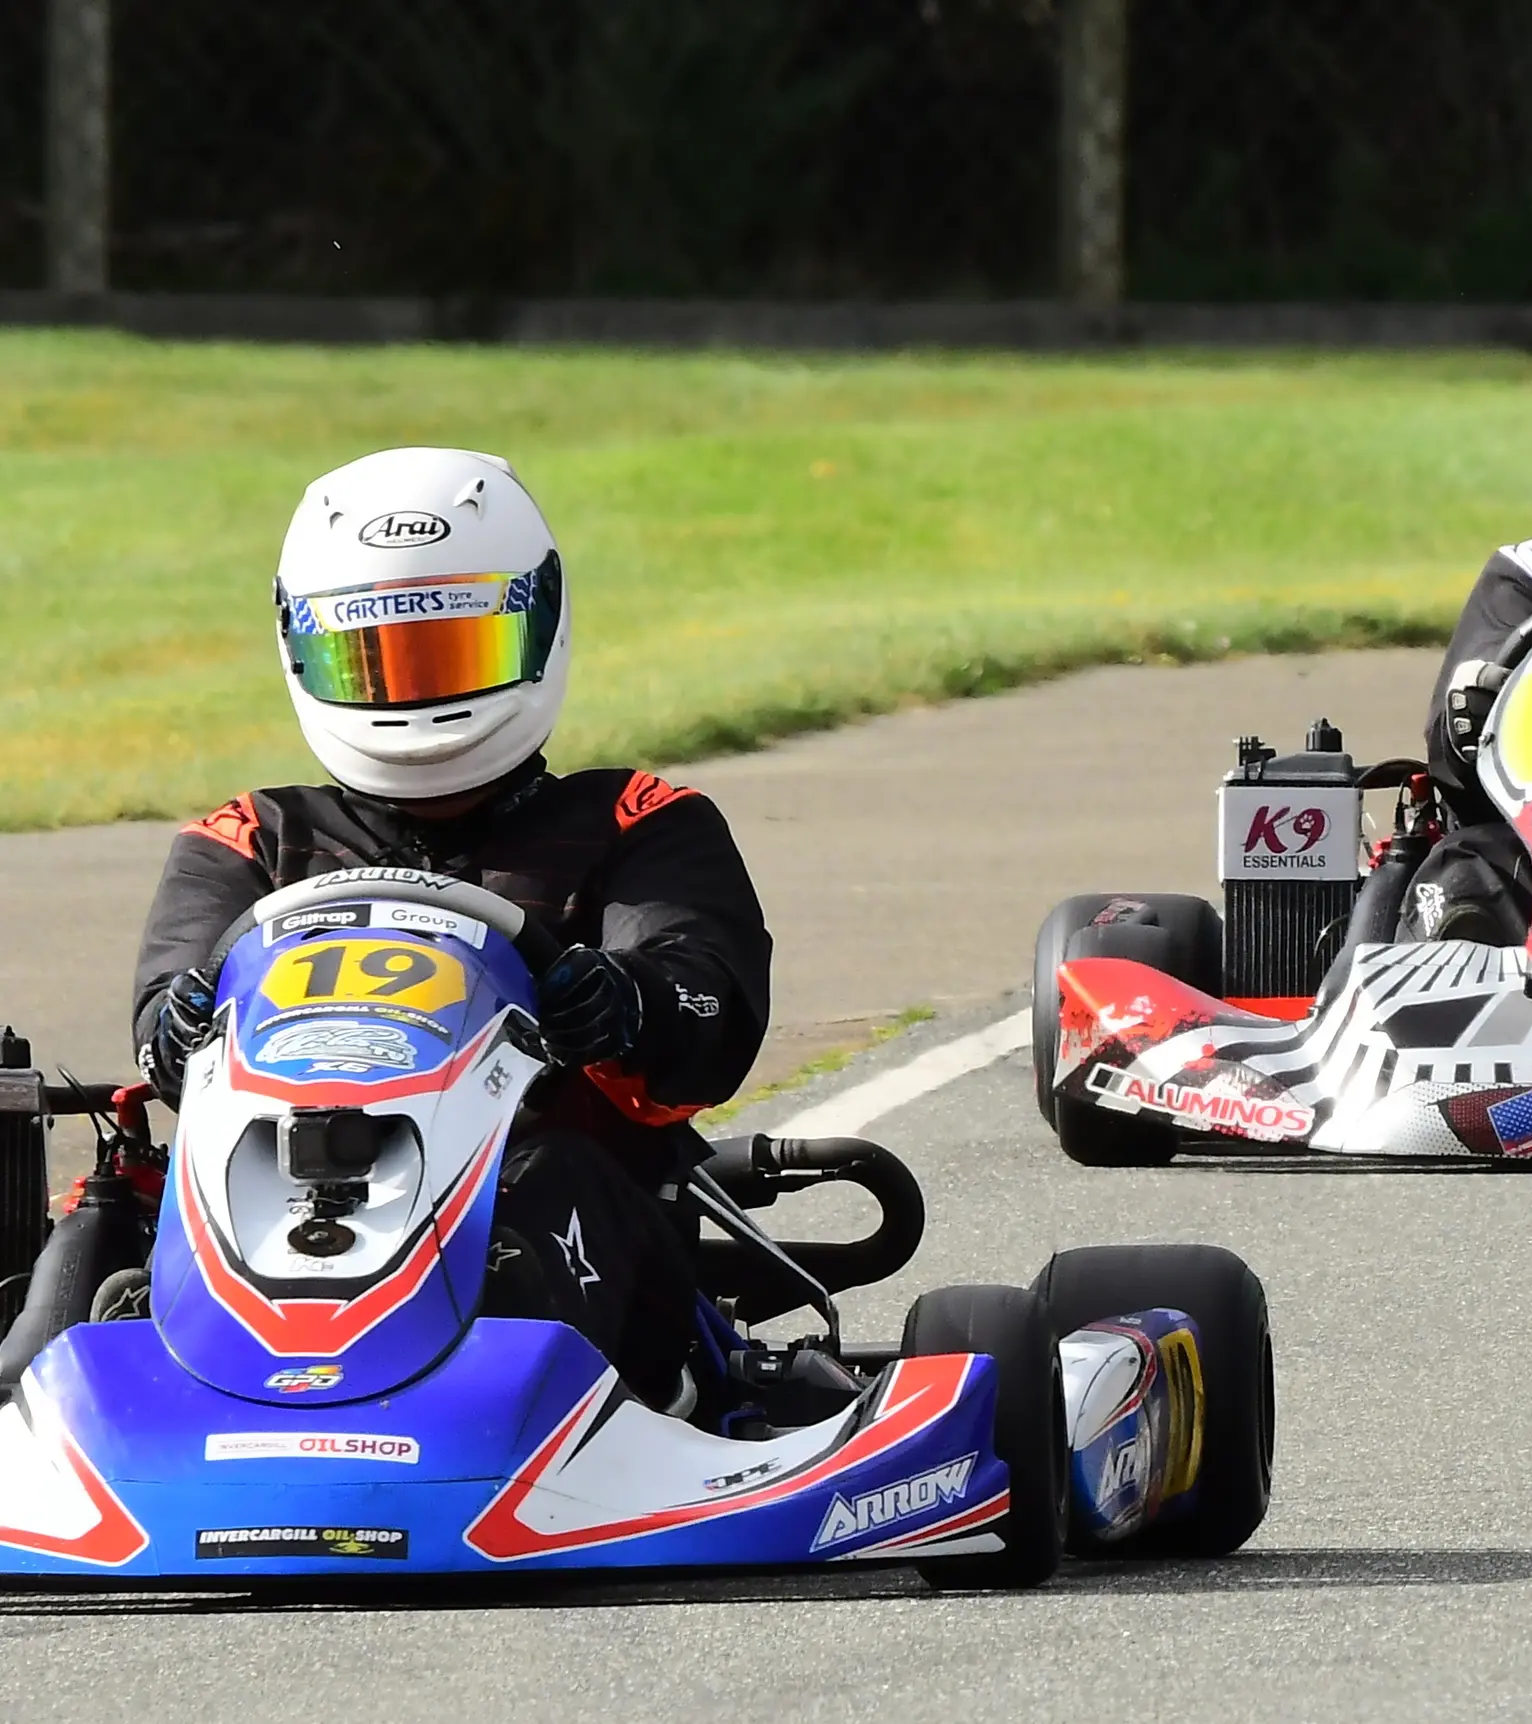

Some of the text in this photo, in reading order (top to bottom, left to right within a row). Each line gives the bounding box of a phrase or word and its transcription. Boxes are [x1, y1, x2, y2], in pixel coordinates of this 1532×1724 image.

[363, 516, 439, 541] Arai
[334, 591, 489, 622] CARTER'S tyre service
[1243, 805, 1326, 854] K9
[1243, 855, 1327, 868] ESSENTIALS
[314, 866, 460, 890] ARROW
[281, 909, 458, 930] Giltrap Group
[293, 946, 437, 999] 19
[1125, 1078, 1312, 1132] ALUMINOS
[811, 1455, 977, 1553] ARROW
[199, 1528, 319, 1545] INVERCARGILL
